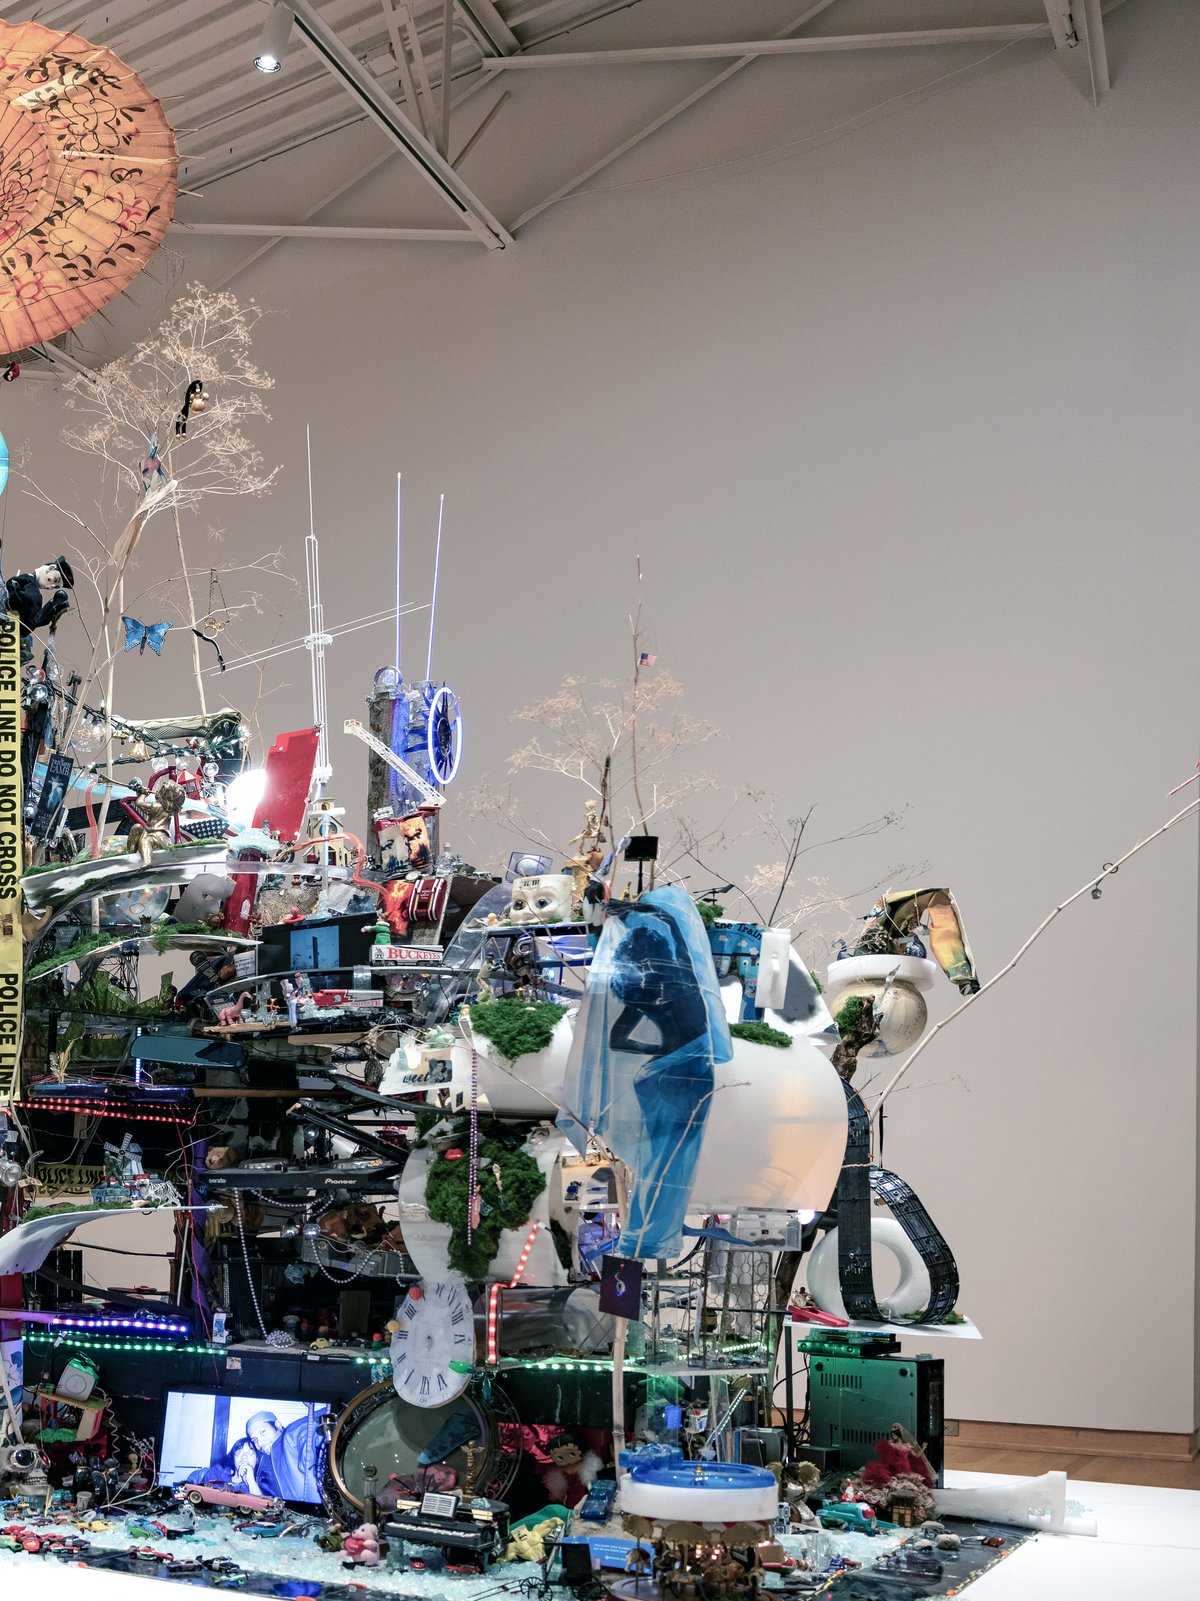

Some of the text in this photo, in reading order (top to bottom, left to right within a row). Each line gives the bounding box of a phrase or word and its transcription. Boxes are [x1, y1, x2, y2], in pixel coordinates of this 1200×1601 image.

[50, 764, 70, 776] LAMB
[738, 924, 763, 941] Train
[386, 947, 441, 960] BUCKEYES
